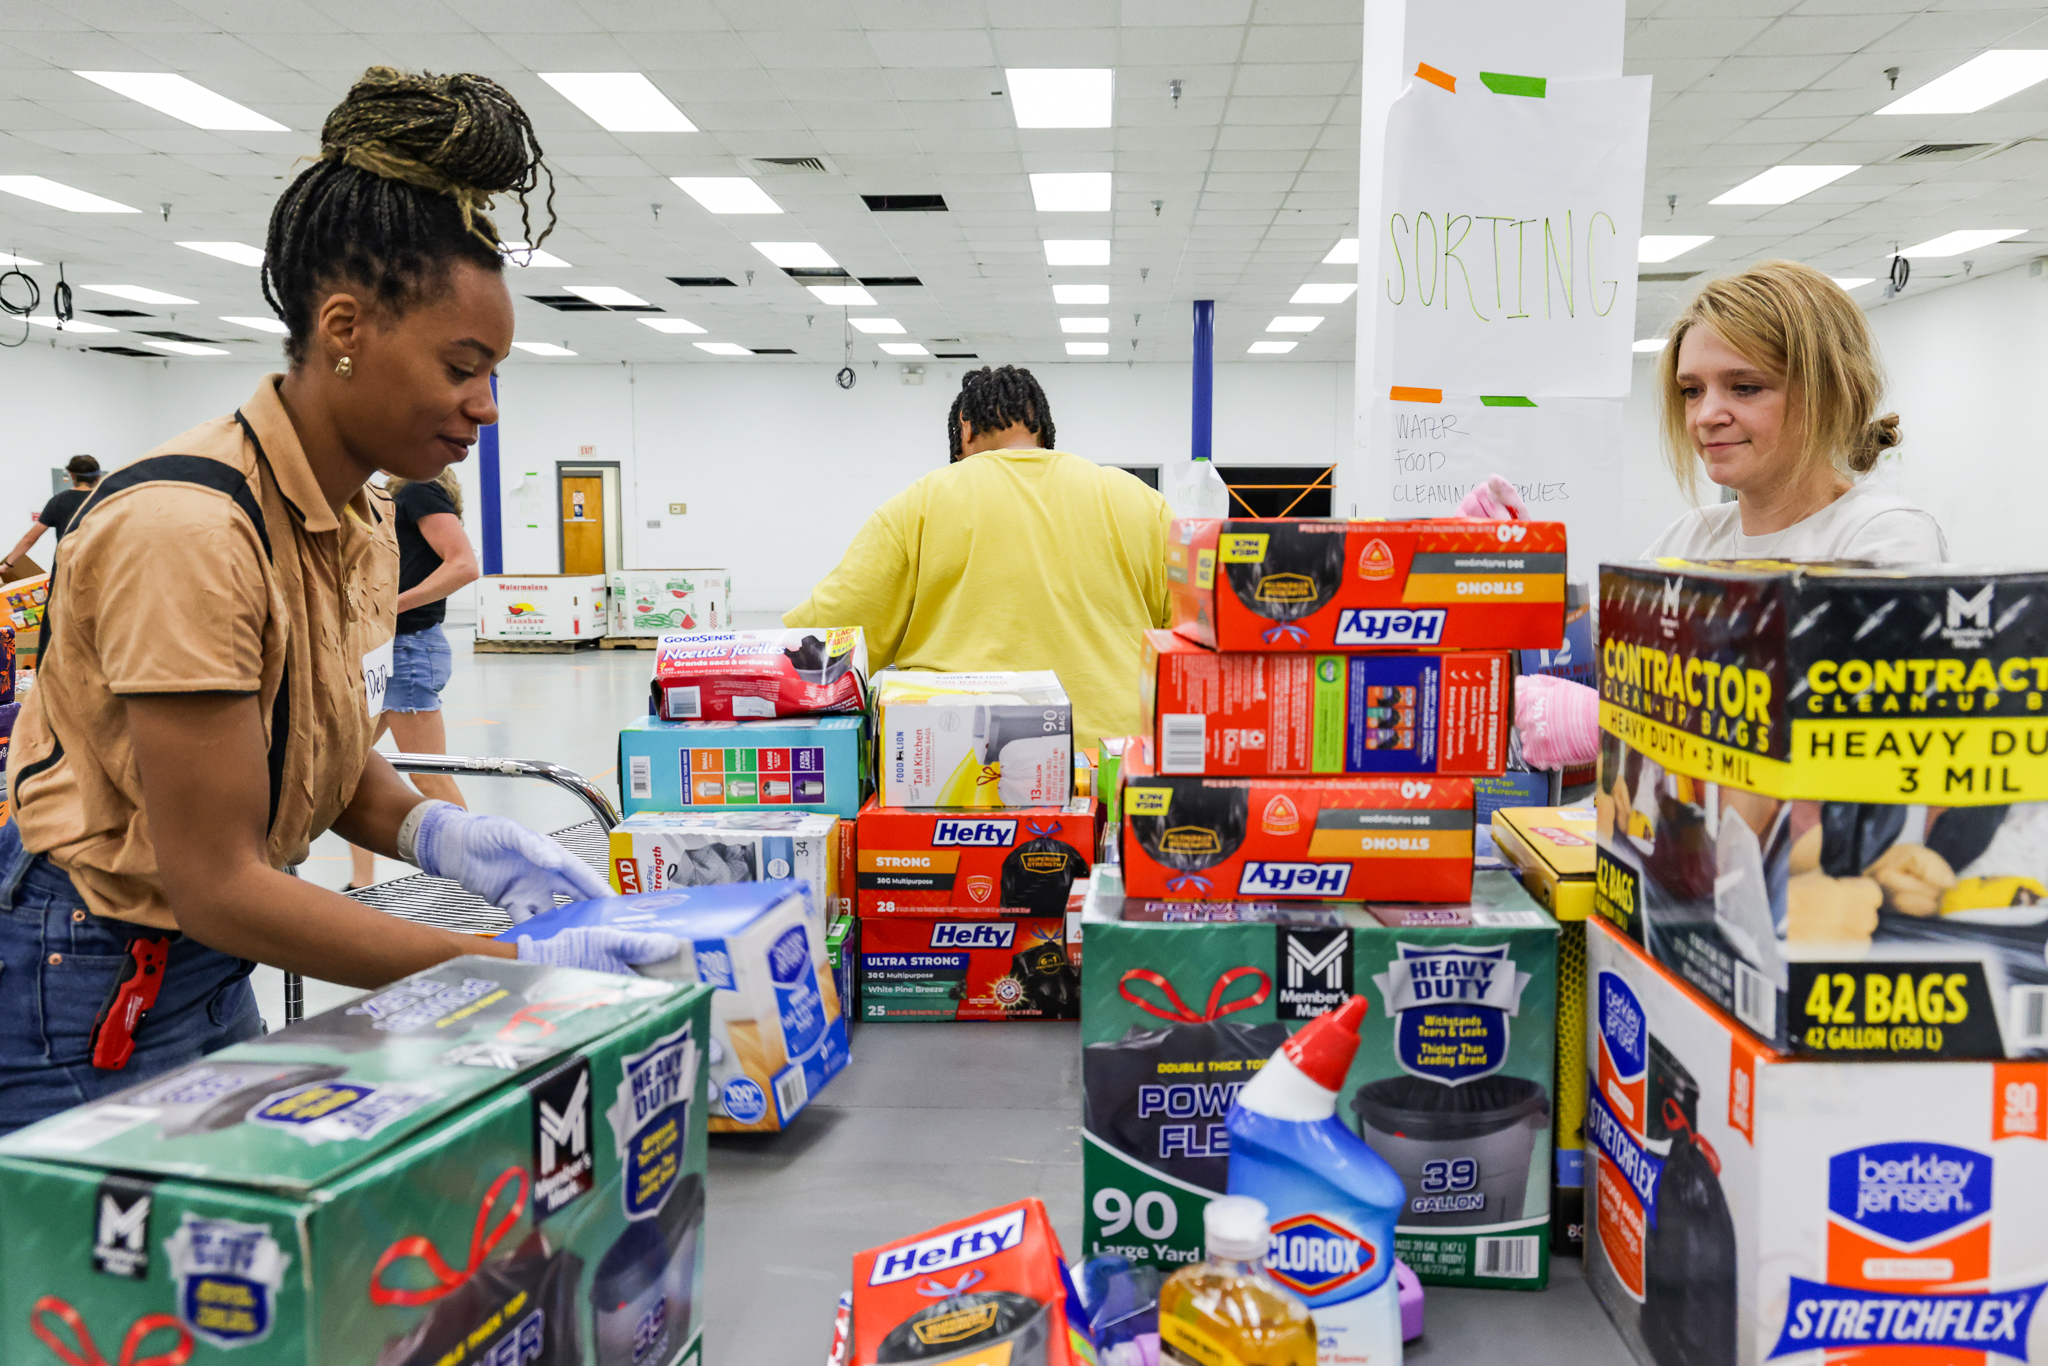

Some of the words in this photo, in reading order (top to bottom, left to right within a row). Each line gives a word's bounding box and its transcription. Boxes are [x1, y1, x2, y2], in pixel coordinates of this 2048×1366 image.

[1387, 210, 1617, 321] SORTING
[1396, 414, 1469, 439] WATER
[1395, 450, 1445, 474] FOOD
[1497, 526, 1526, 542] 40
[1456, 582, 1524, 595] STRONG
[1344, 610, 1438, 639] Hefty
[728, 642, 786, 659] faciles
[1603, 637, 1772, 726] CONTRACTOR
[1043, 710, 1058, 732] 90
[1058, 711, 1066, 731] BAGS
[1701, 710, 1769, 753] BAGS
[896, 731, 904, 750] LION
[914, 729, 923, 766] Kitchen
[1610, 709, 1646, 743] HEAVY
[1651, 725, 1686, 760] DUTY
[1706, 747, 1714, 771] 3
[1722, 754, 1755, 786] MIL
[1811, 730, 1966, 758] HEAVY
[896, 762, 904, 783] FOOD
[914, 769, 923, 785] Tall
[1900, 766, 1919, 793] 3
[1945, 766, 2021, 792] MIL
[1031, 789, 1042, 801] 13
[1401, 781, 1432, 799] 40
[1487, 787, 1529, 796] Environment
[938, 823, 1011, 846] Hefty
[1361, 838, 1431, 850] STRONG
[796, 841, 809, 857] 34
[876, 857, 931, 867] STRONG
[620, 859, 641, 895] LAD
[1249, 865, 1344, 892] Hefty
[1596, 856, 1609, 895] 42
[1608, 864, 1635, 915] BAGS
[877, 902, 895, 912] 28
[936, 926, 1011, 947] Hefty
[867, 957, 907, 966] ULTRA
[911, 957, 960, 966] STRONG
[1409, 961, 1496, 978] HEAVY
[886, 972, 934, 980] Multipurpose
[1413, 979, 1493, 1000] DUTY
[1805, 973, 1856, 1024] 42
[1864, 973, 1969, 1024] BAGS
[868, 1006, 885, 1016] 25
[1606, 980, 1642, 1038] berkley
[1417, 1026, 1446, 1037] Tears
[1448, 1028, 1456, 1037] &
[1459, 1027, 1488, 1037] Leaks
[1424, 1015, 1482, 1026] Withstands
[1421, 1043, 1458, 1054] Thicker
[1460, 1043, 1484, 1054] Than
[1805, 1027, 1825, 1050] 42
[1826, 1027, 1888, 1050] GALLON
[1157, 1062, 1205, 1074] DOUBLE
[1208, 1061, 1242, 1072] THICK
[1417, 1055, 1455, 1068] Leading
[1458, 1054, 1487, 1065] Brand
[635, 1071, 681, 1122] DUTY
[1138, 1083, 1250, 1119] POW
[2003, 1082, 2038, 1115] 90
[1159, 1123, 1231, 1158] FLE
[1589, 1097, 1658, 1205] STRETCHFLEX
[1421, 1157, 1477, 1193] 39
[1858, 1153, 1975, 1191] berkley
[1092, 1187, 1178, 1240] 90
[1411, 1193, 1485, 1213] GALLON
[1855, 1189, 1965, 1220] jensen
[883, 1223, 1015, 1277] Hefty
[1152, 1243, 1199, 1263] Yard
[1263, 1234, 1361, 1274] CLOROX
[1424, 1241, 1439, 1251] GAL
[1788, 1299, 2028, 1341] STRETCHFLEX
